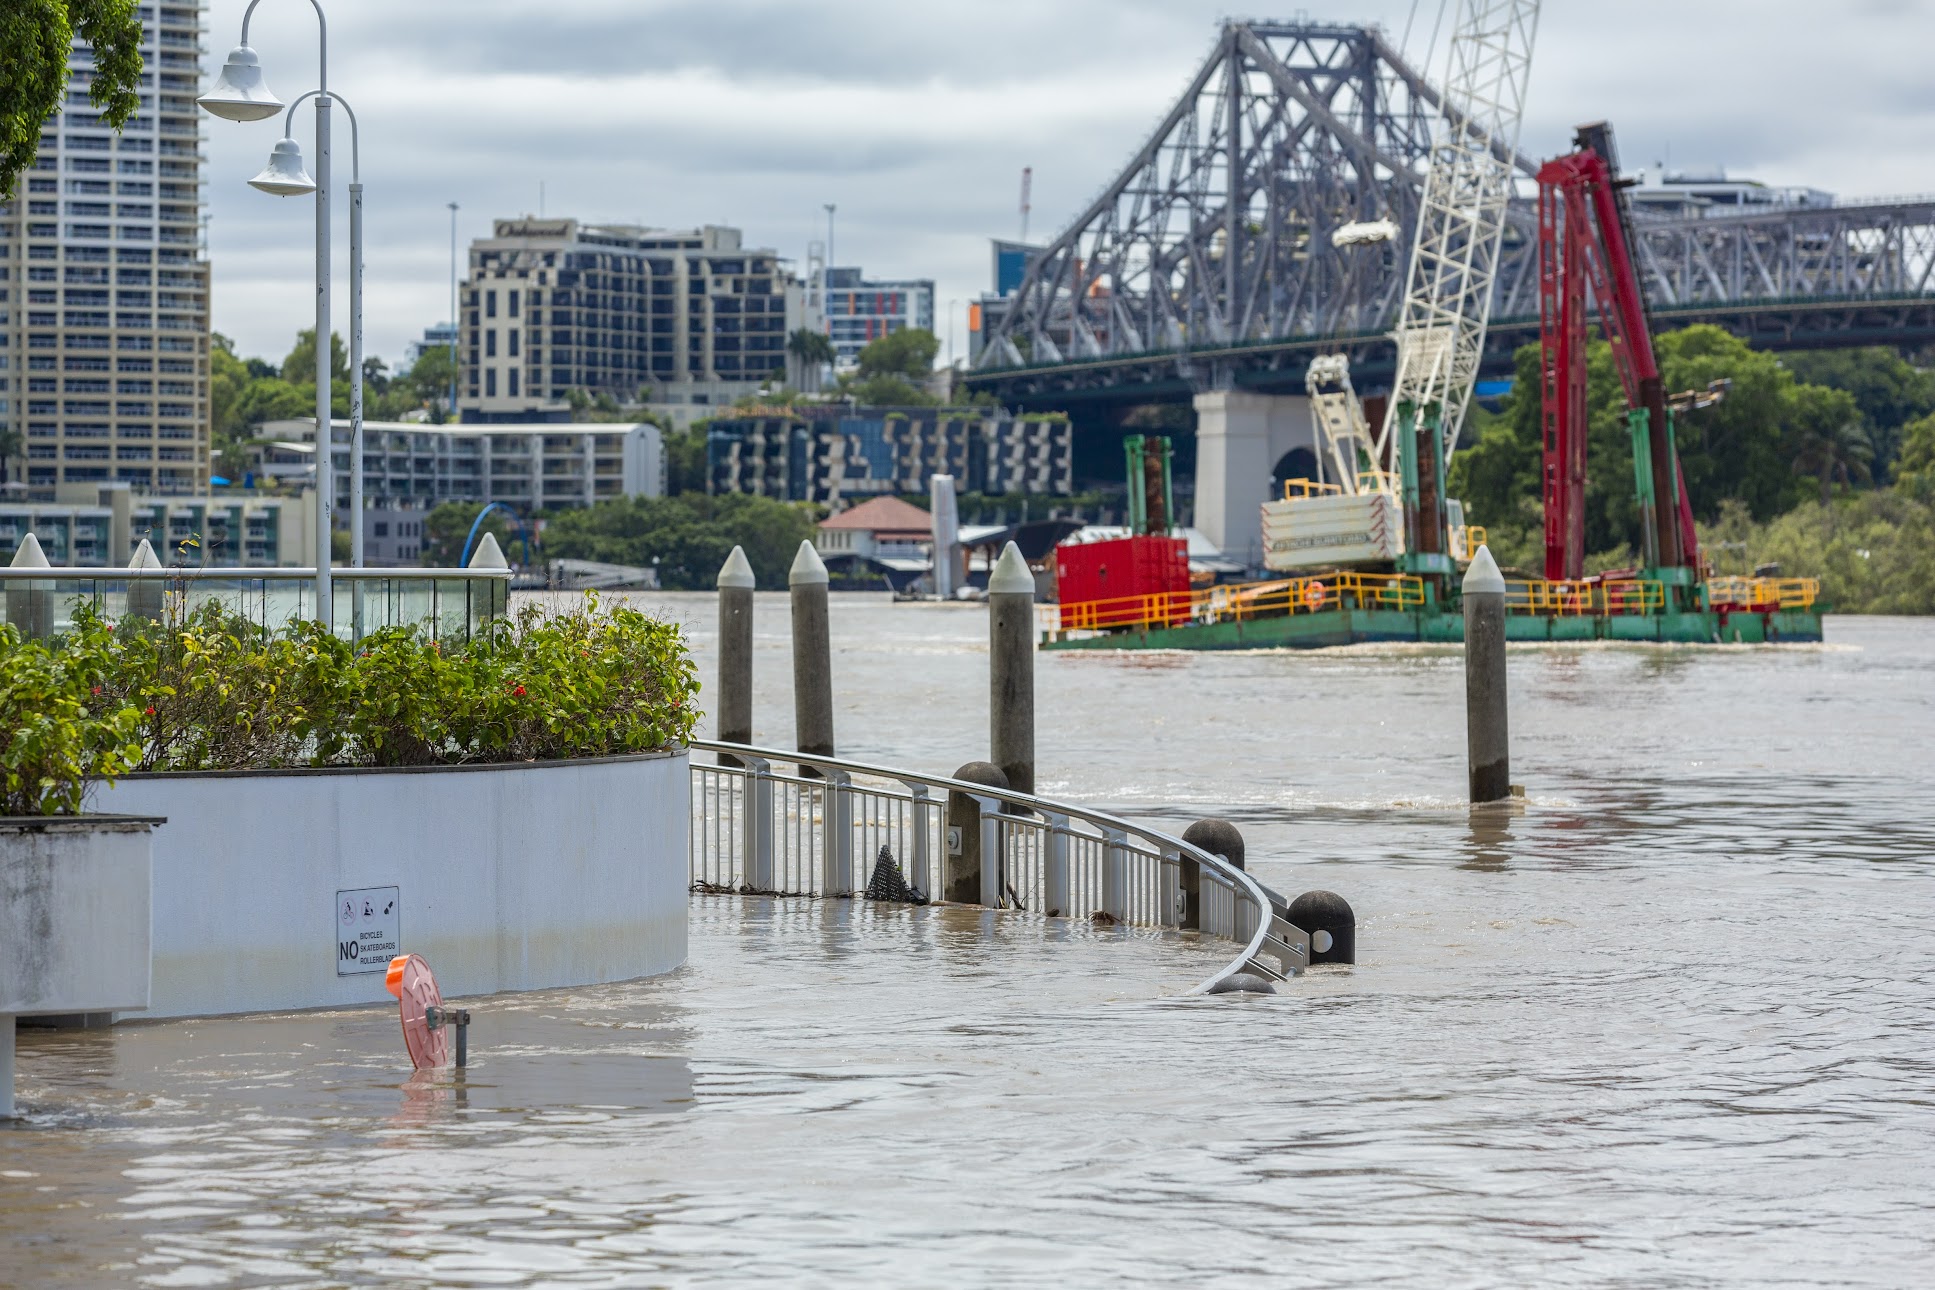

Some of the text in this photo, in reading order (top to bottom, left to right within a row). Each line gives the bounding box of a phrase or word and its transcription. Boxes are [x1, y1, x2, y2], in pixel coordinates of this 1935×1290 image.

[360, 931, 383, 940] BICYCLES
[340, 941, 359, 960] NO
[360, 942, 396, 952] SKATEBOARDS
